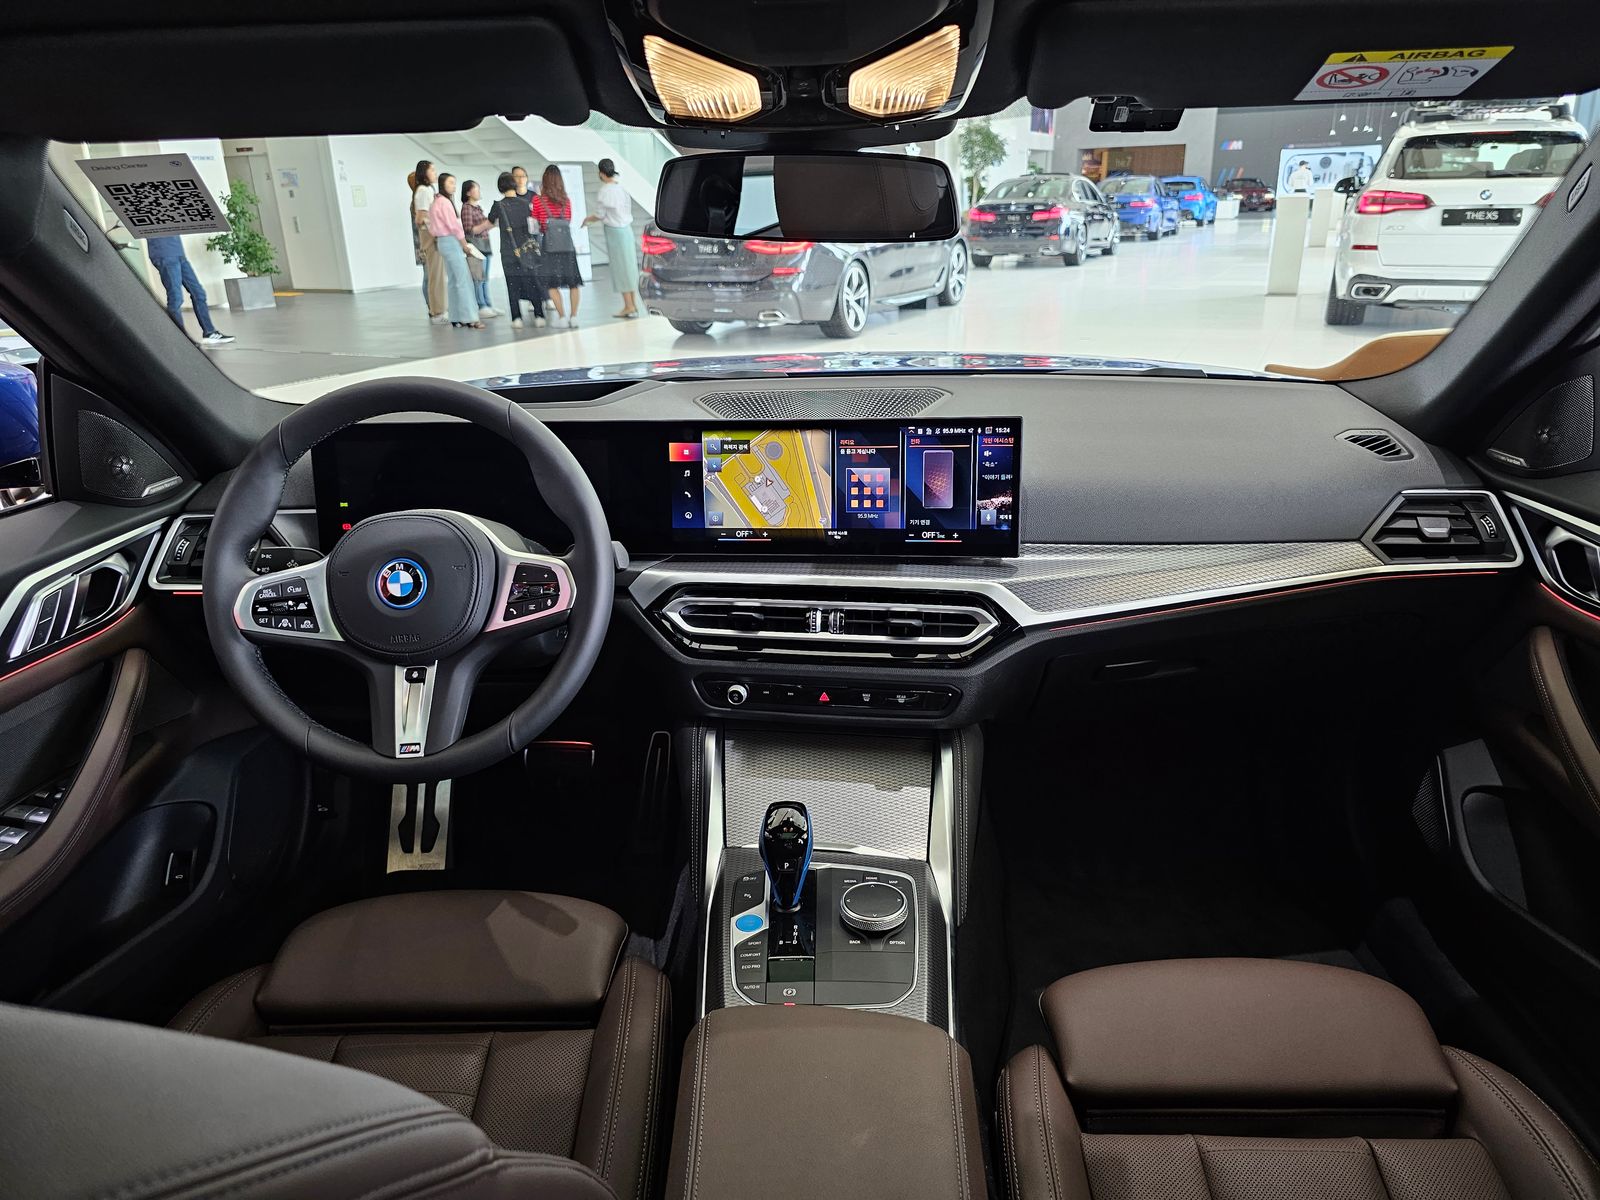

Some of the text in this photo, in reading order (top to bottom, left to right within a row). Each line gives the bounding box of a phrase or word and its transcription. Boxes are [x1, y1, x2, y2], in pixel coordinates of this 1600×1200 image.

[1388, 49, 1486, 60] AIRBAG
[91, 163, 121, 172] Driving
[1465, 210, 1486, 220] THE
[698, 244, 712, 254] THE
[921, 531, 936, 539] OFF
[390, 633, 420, 643] AIRBAG
